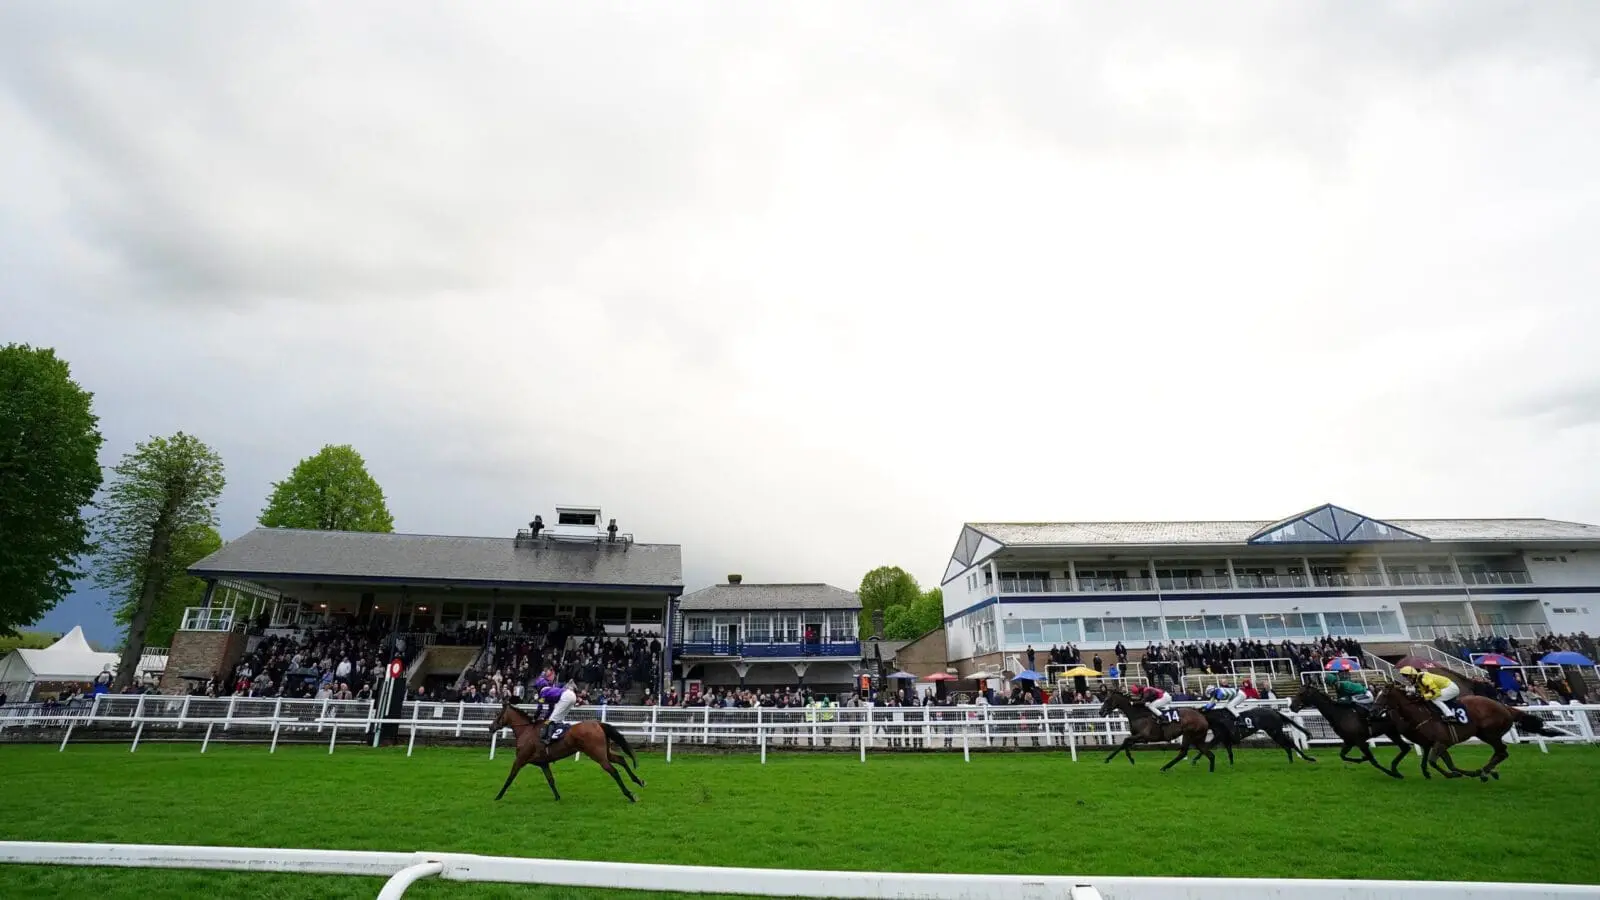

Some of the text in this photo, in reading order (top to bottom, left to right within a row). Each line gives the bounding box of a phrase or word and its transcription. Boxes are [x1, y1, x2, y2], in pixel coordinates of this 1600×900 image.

[1164, 710, 1180, 723] 14
[1244, 717, 1255, 729] 9
[551, 728, 563, 739] 2
